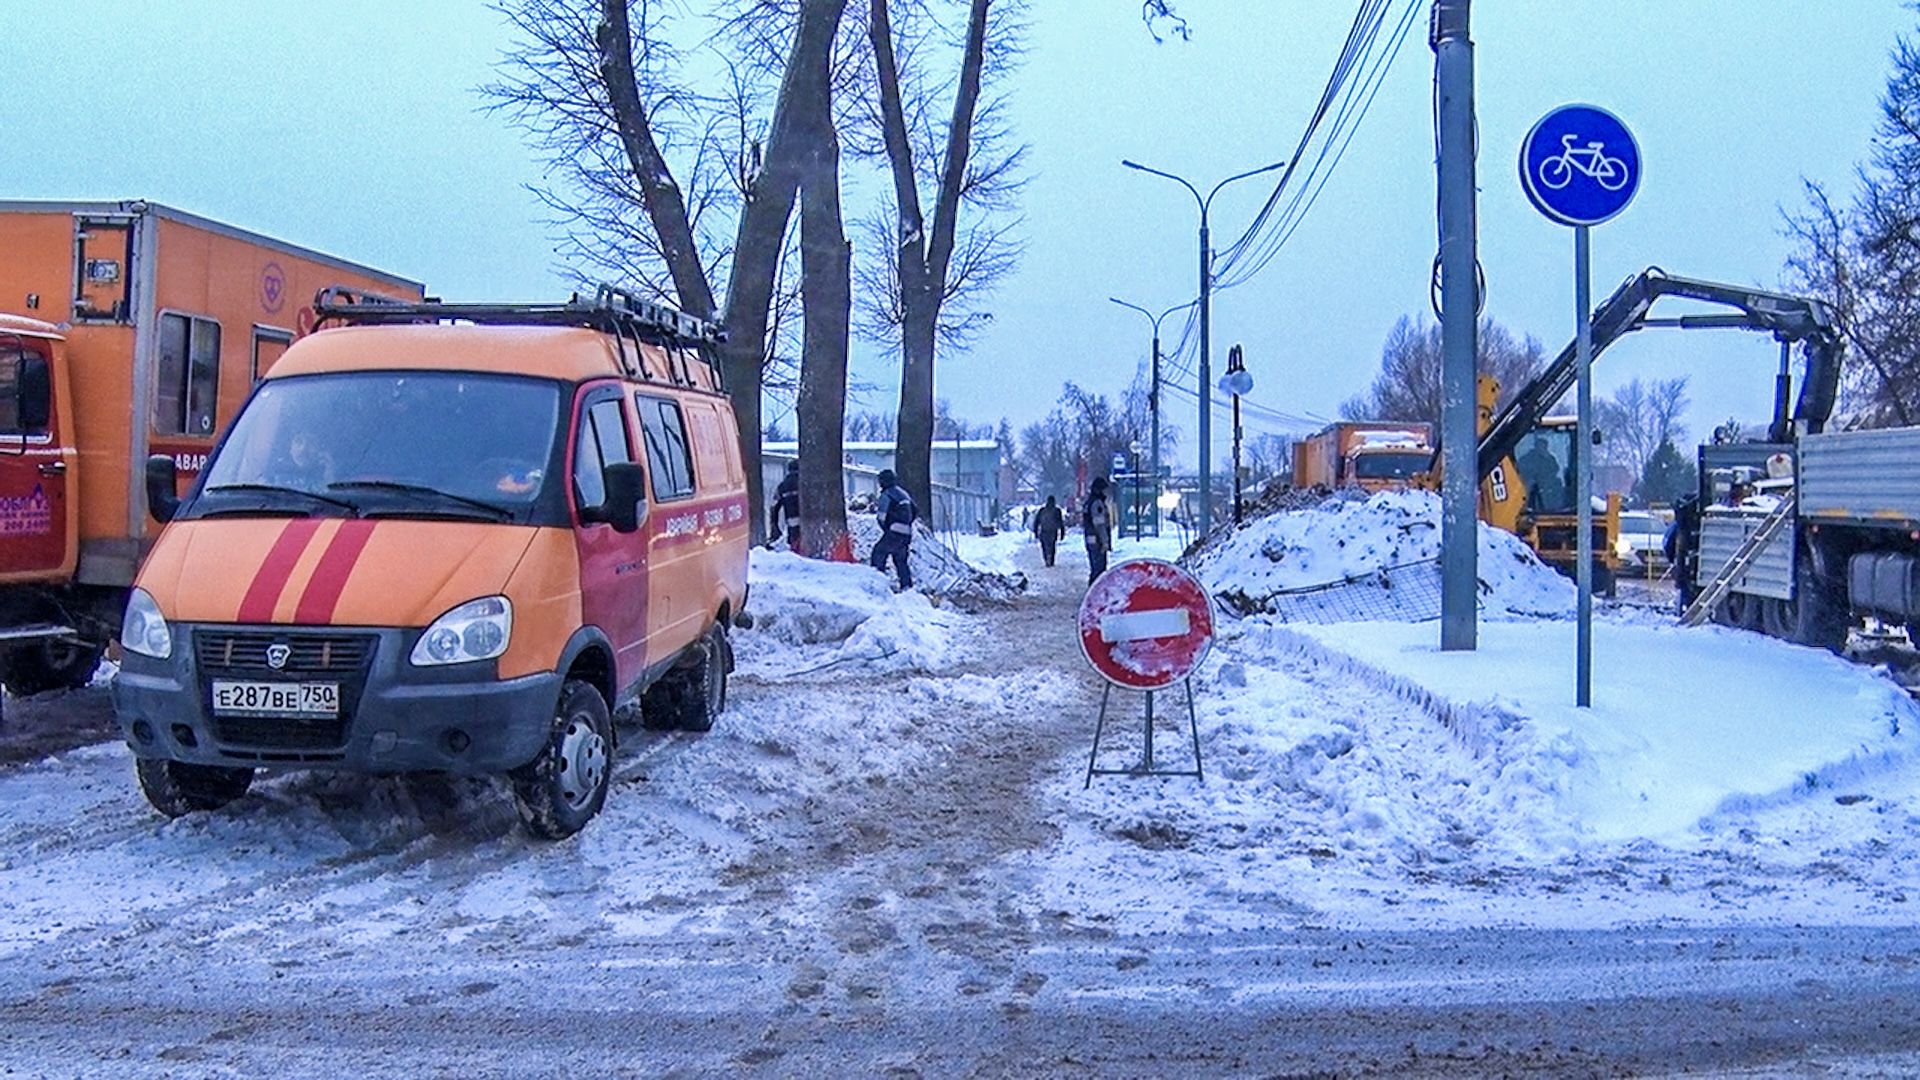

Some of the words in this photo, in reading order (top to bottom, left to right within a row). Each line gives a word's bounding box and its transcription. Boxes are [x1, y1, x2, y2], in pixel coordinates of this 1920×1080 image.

[1490, 464, 1507, 501] CB
[220, 685, 297, 708] Е287ВЕ
[302, 686, 333, 703] 750
